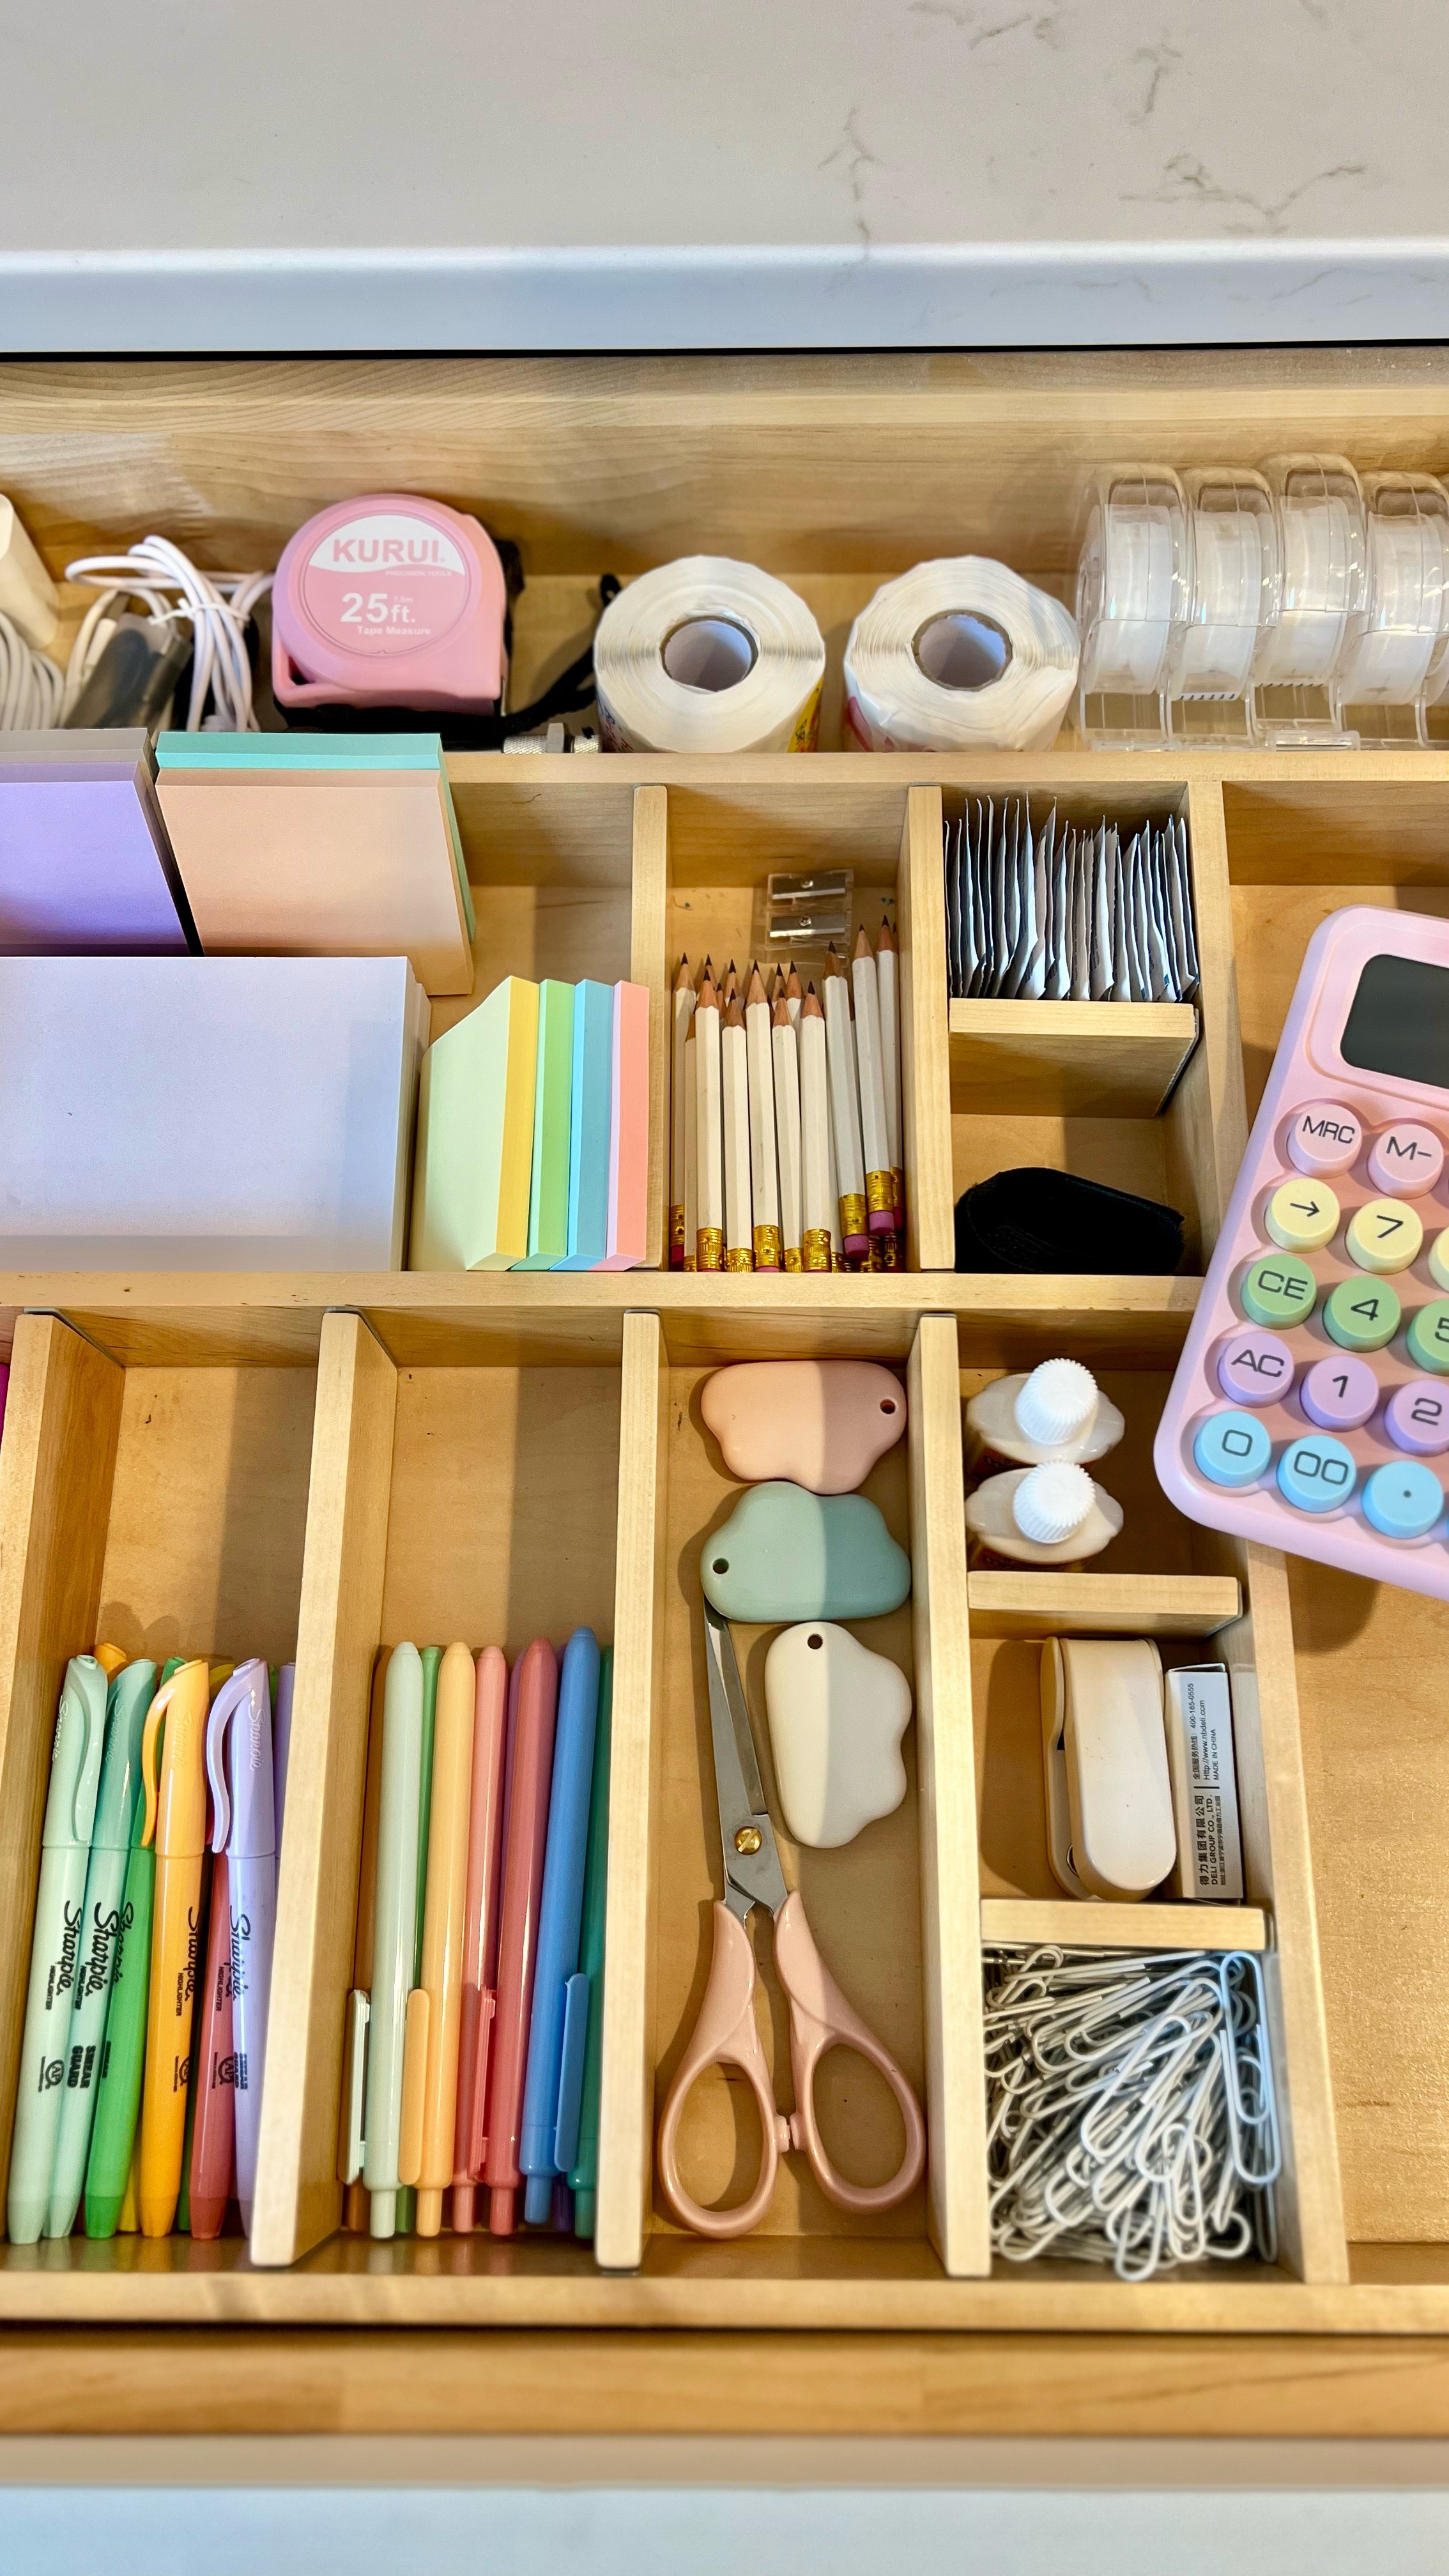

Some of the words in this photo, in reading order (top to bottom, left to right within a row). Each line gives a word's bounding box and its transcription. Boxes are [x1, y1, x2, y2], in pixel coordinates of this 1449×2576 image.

[333, 539, 439, 563] KURUI
[356, 625, 383, 636] Tape
[386, 626, 431, 635] Measure
[1302, 1116, 1355, 1144] MRC
[1376, 1215, 1404, 1238] 7
[1257, 1270, 1308, 1300] CE
[1350, 1299, 1379, 1321] 4
[1231, 1349, 1284, 1377] AC
[1332, 1376, 1349, 1398] 1
[1411, 1397, 1442, 1425] 2
[1222, 1429, 1253, 1457] 0
[1293, 1450, 1349, 1485] 00
[1187, 1683, 1196, 1729] 400-185-0555
[245, 1703, 266, 1771] Sharpie
[1194, 1795, 1209, 1885] 得力集团有限公司
[1208, 1835, 1216, 1864] GROUP
[45, 1965, 56, 2010] HIGHLIGHTER
[75, 1965, 87, 2010] HIGHLIGHTER
[176, 1972, 184, 2016] HIGHLIGHTER
[216, 1966, 224, 2011] HIGHLIGHTER
[67, 2045, 84, 2088] GUARD
[80, 2045, 96, 2089] SMEAR
